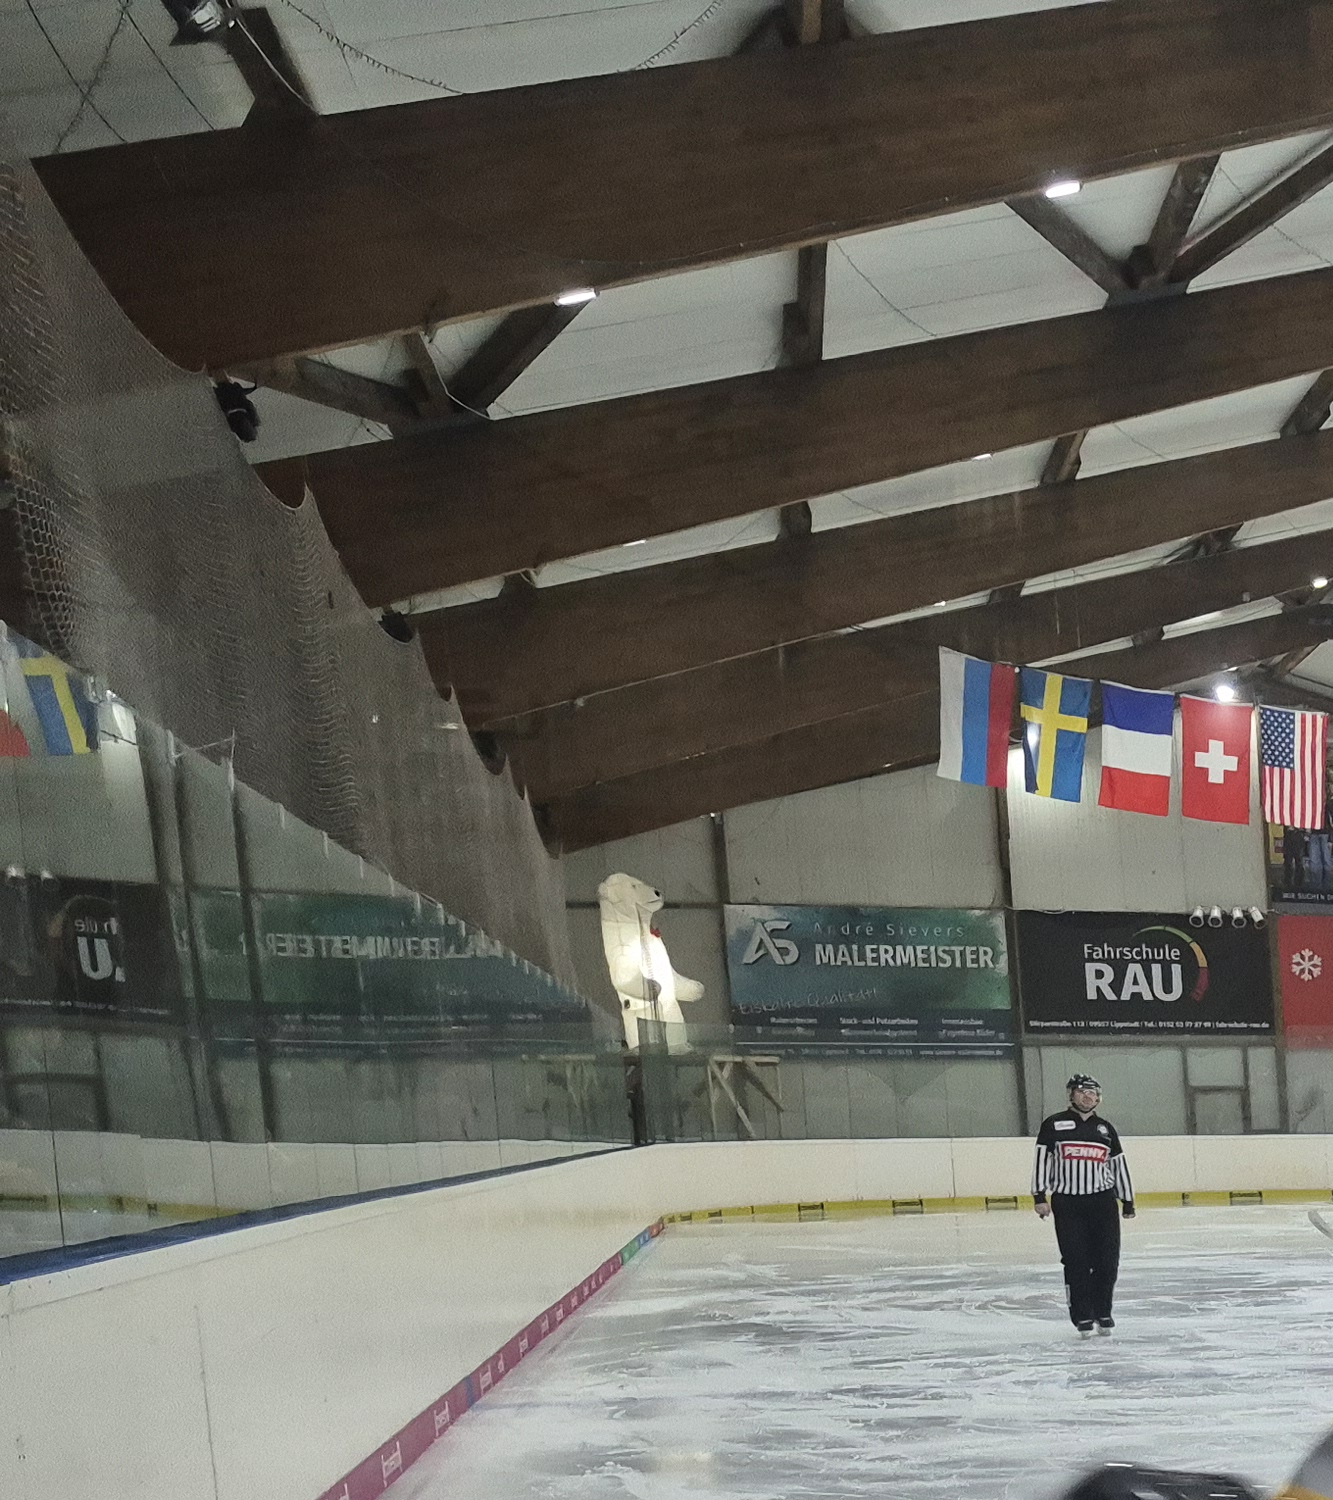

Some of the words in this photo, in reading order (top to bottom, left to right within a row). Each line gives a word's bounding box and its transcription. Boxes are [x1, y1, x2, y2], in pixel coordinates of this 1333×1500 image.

[813, 921, 873, 937] André
[887, 923, 965, 938] Sievers
[815, 943, 996, 968] MALERMEISTER
[1084, 943, 1180, 960] Fahrschule
[1084, 962, 1183, 1002] RAU
